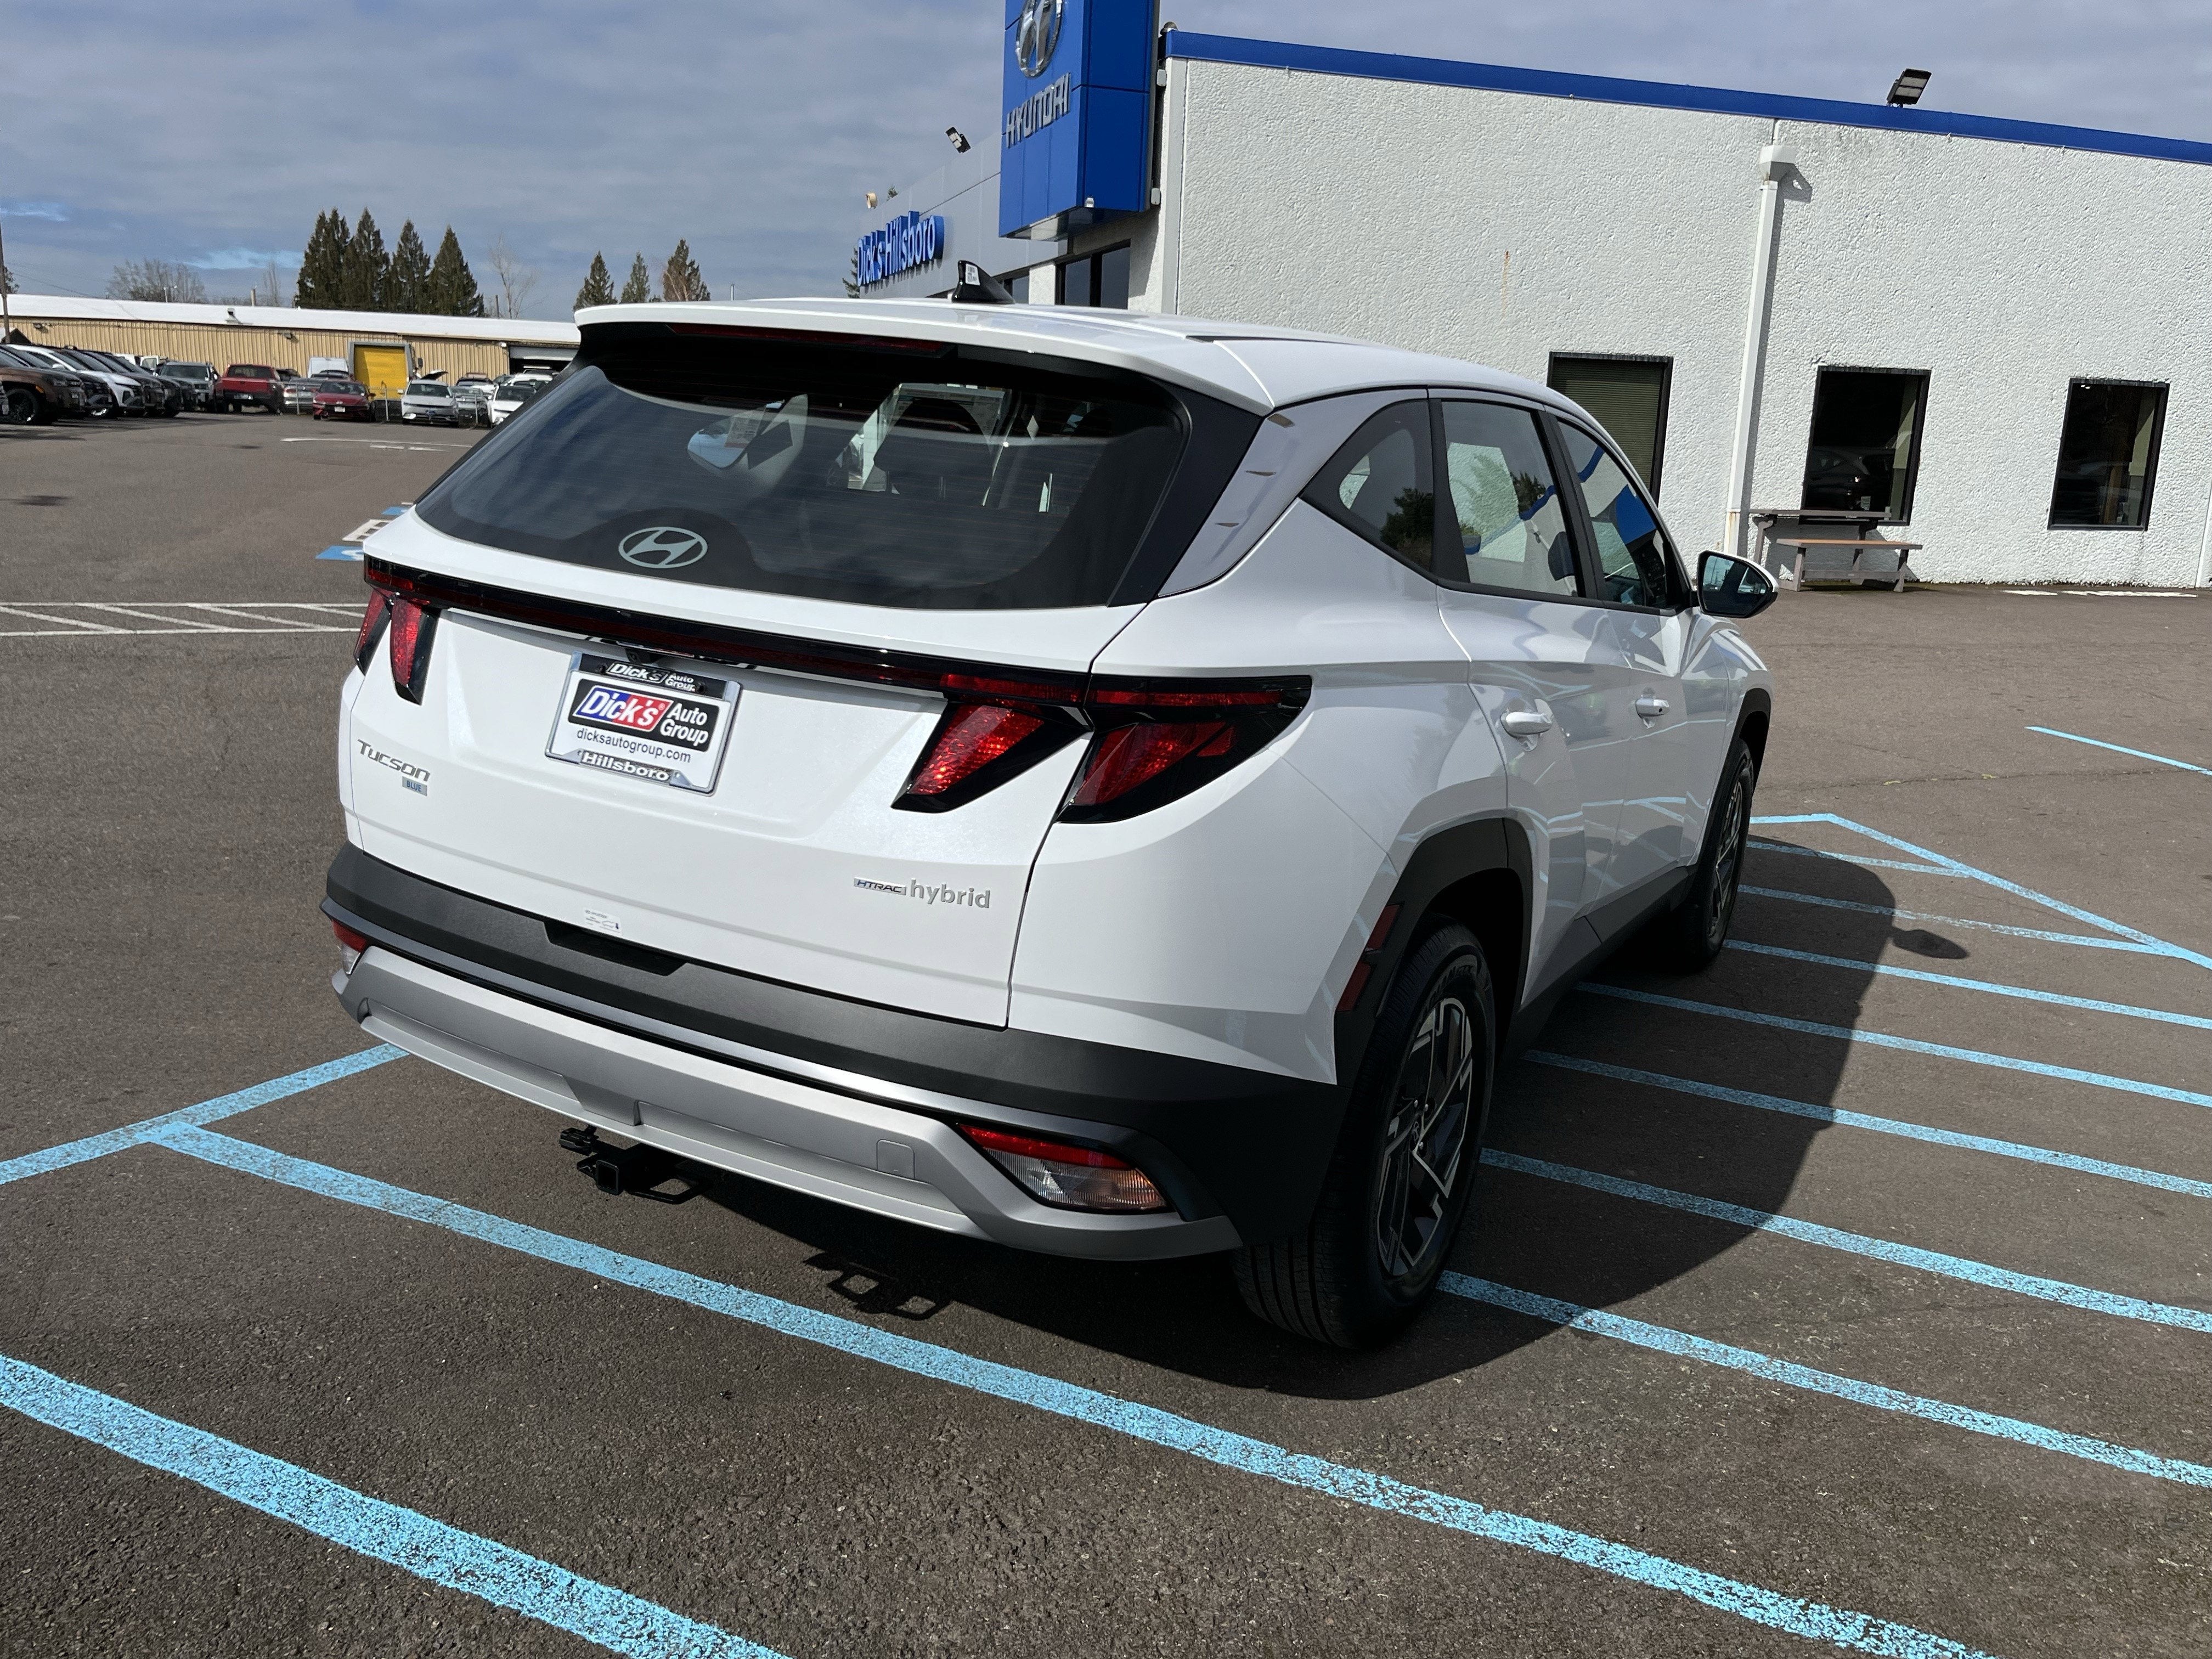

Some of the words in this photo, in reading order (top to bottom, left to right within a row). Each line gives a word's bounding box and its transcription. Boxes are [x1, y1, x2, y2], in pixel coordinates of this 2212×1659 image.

[1006, 71, 1070, 149] HYUNDAI
[857, 230, 884, 287] Dick's
[885, 211, 943, 276] Hillsboro
[610, 663, 662, 681] Dick's
[668, 673, 694, 683] Auto
[581, 690, 659, 726] Dick's
[667, 702, 708, 726] Auto
[577, 728, 691, 763] dicksautogroup.com
[660, 718, 709, 746] Group
[357, 738, 431, 782] Tucson
[582, 752, 670, 781] Hillsboro
[406, 780, 422, 792] BLUE
[857, 879, 903, 893] HTRAC
[910, 878, 991, 909] hybrid
